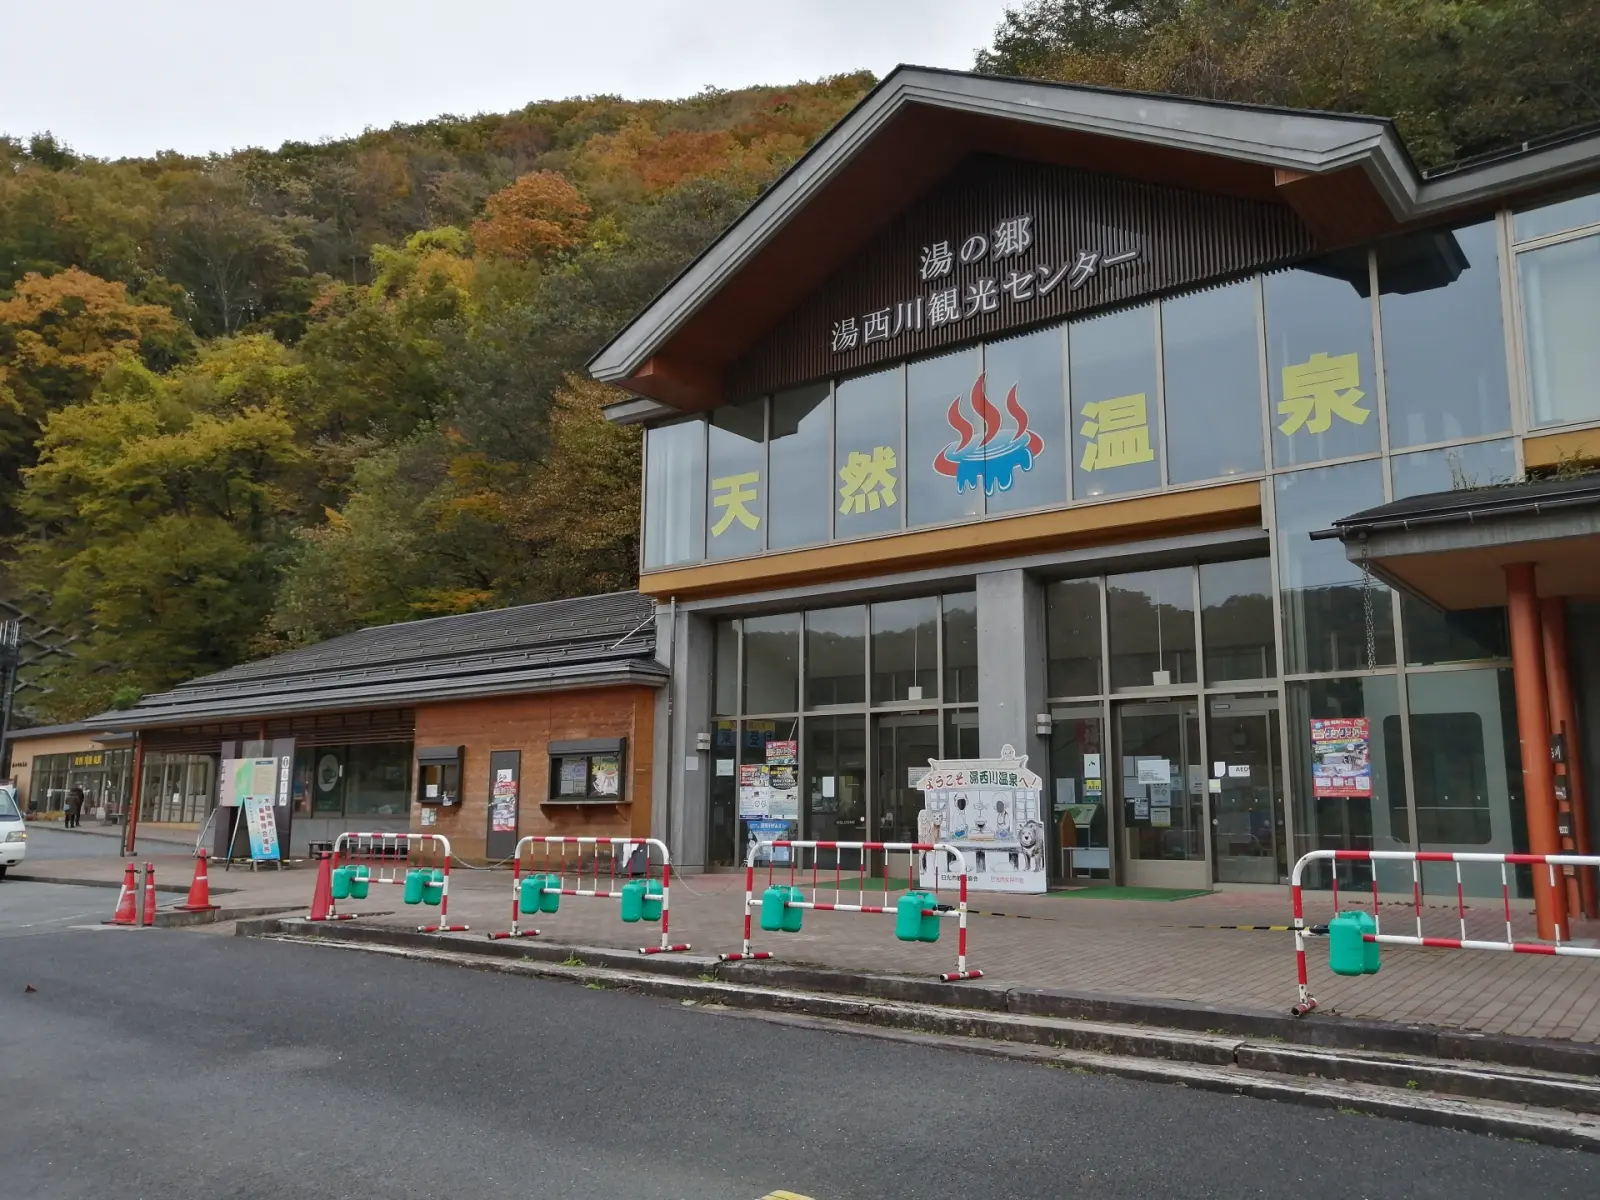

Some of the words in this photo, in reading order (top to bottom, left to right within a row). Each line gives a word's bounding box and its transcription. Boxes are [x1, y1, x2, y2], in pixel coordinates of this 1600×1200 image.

[920, 215, 1033, 280] 湯の郷
[831, 250, 1140, 351] 湯西川観光センター
